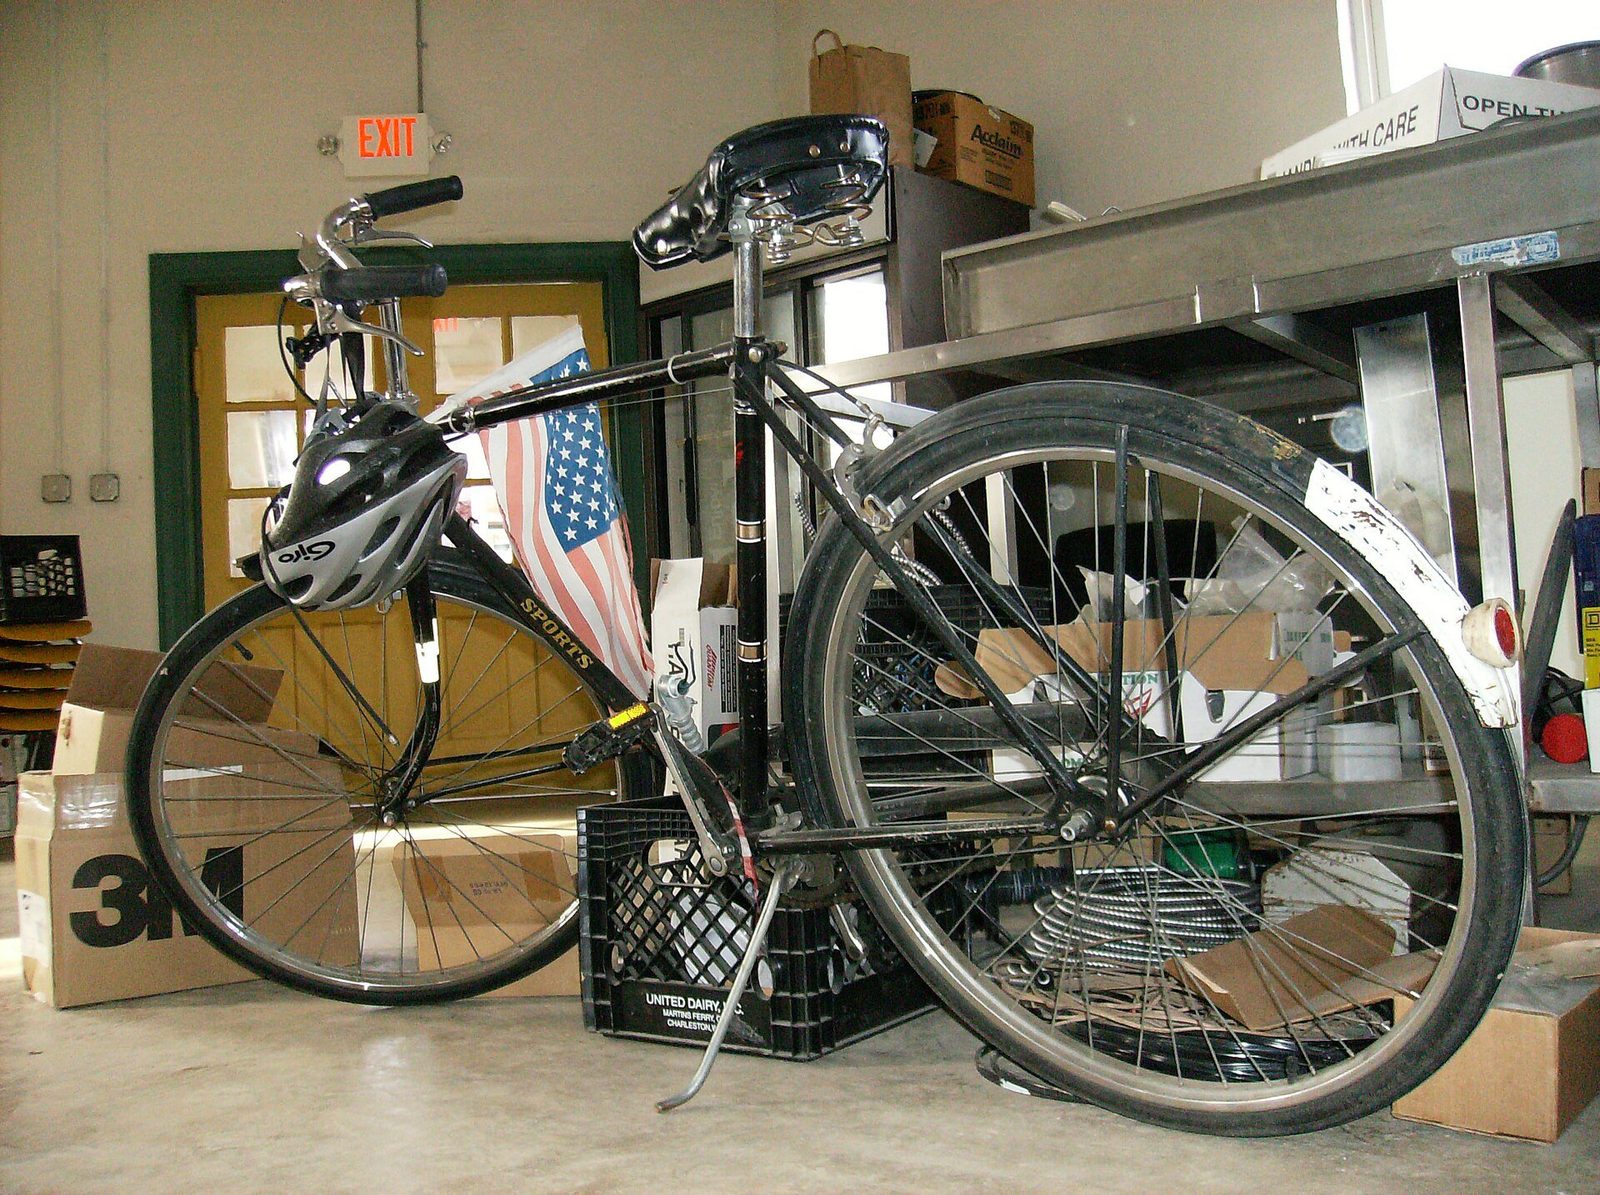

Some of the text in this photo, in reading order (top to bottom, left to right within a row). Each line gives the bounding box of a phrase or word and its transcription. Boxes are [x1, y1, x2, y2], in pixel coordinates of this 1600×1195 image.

[1462, 95, 1527, 117] OPEN
[357, 116, 417, 158] EXIT
[970, 124, 1024, 157] Acclaim
[1373, 105, 1419, 147] CARE
[278, 541, 336, 563] Giro
[520, 598, 594, 670] SPORTS
[69, 846, 244, 948] 3M
[646, 993, 686, 1008] UNITED
[687, 997, 721, 1013] DAIRY,
[662, 1009, 692, 1020] MARTINS
